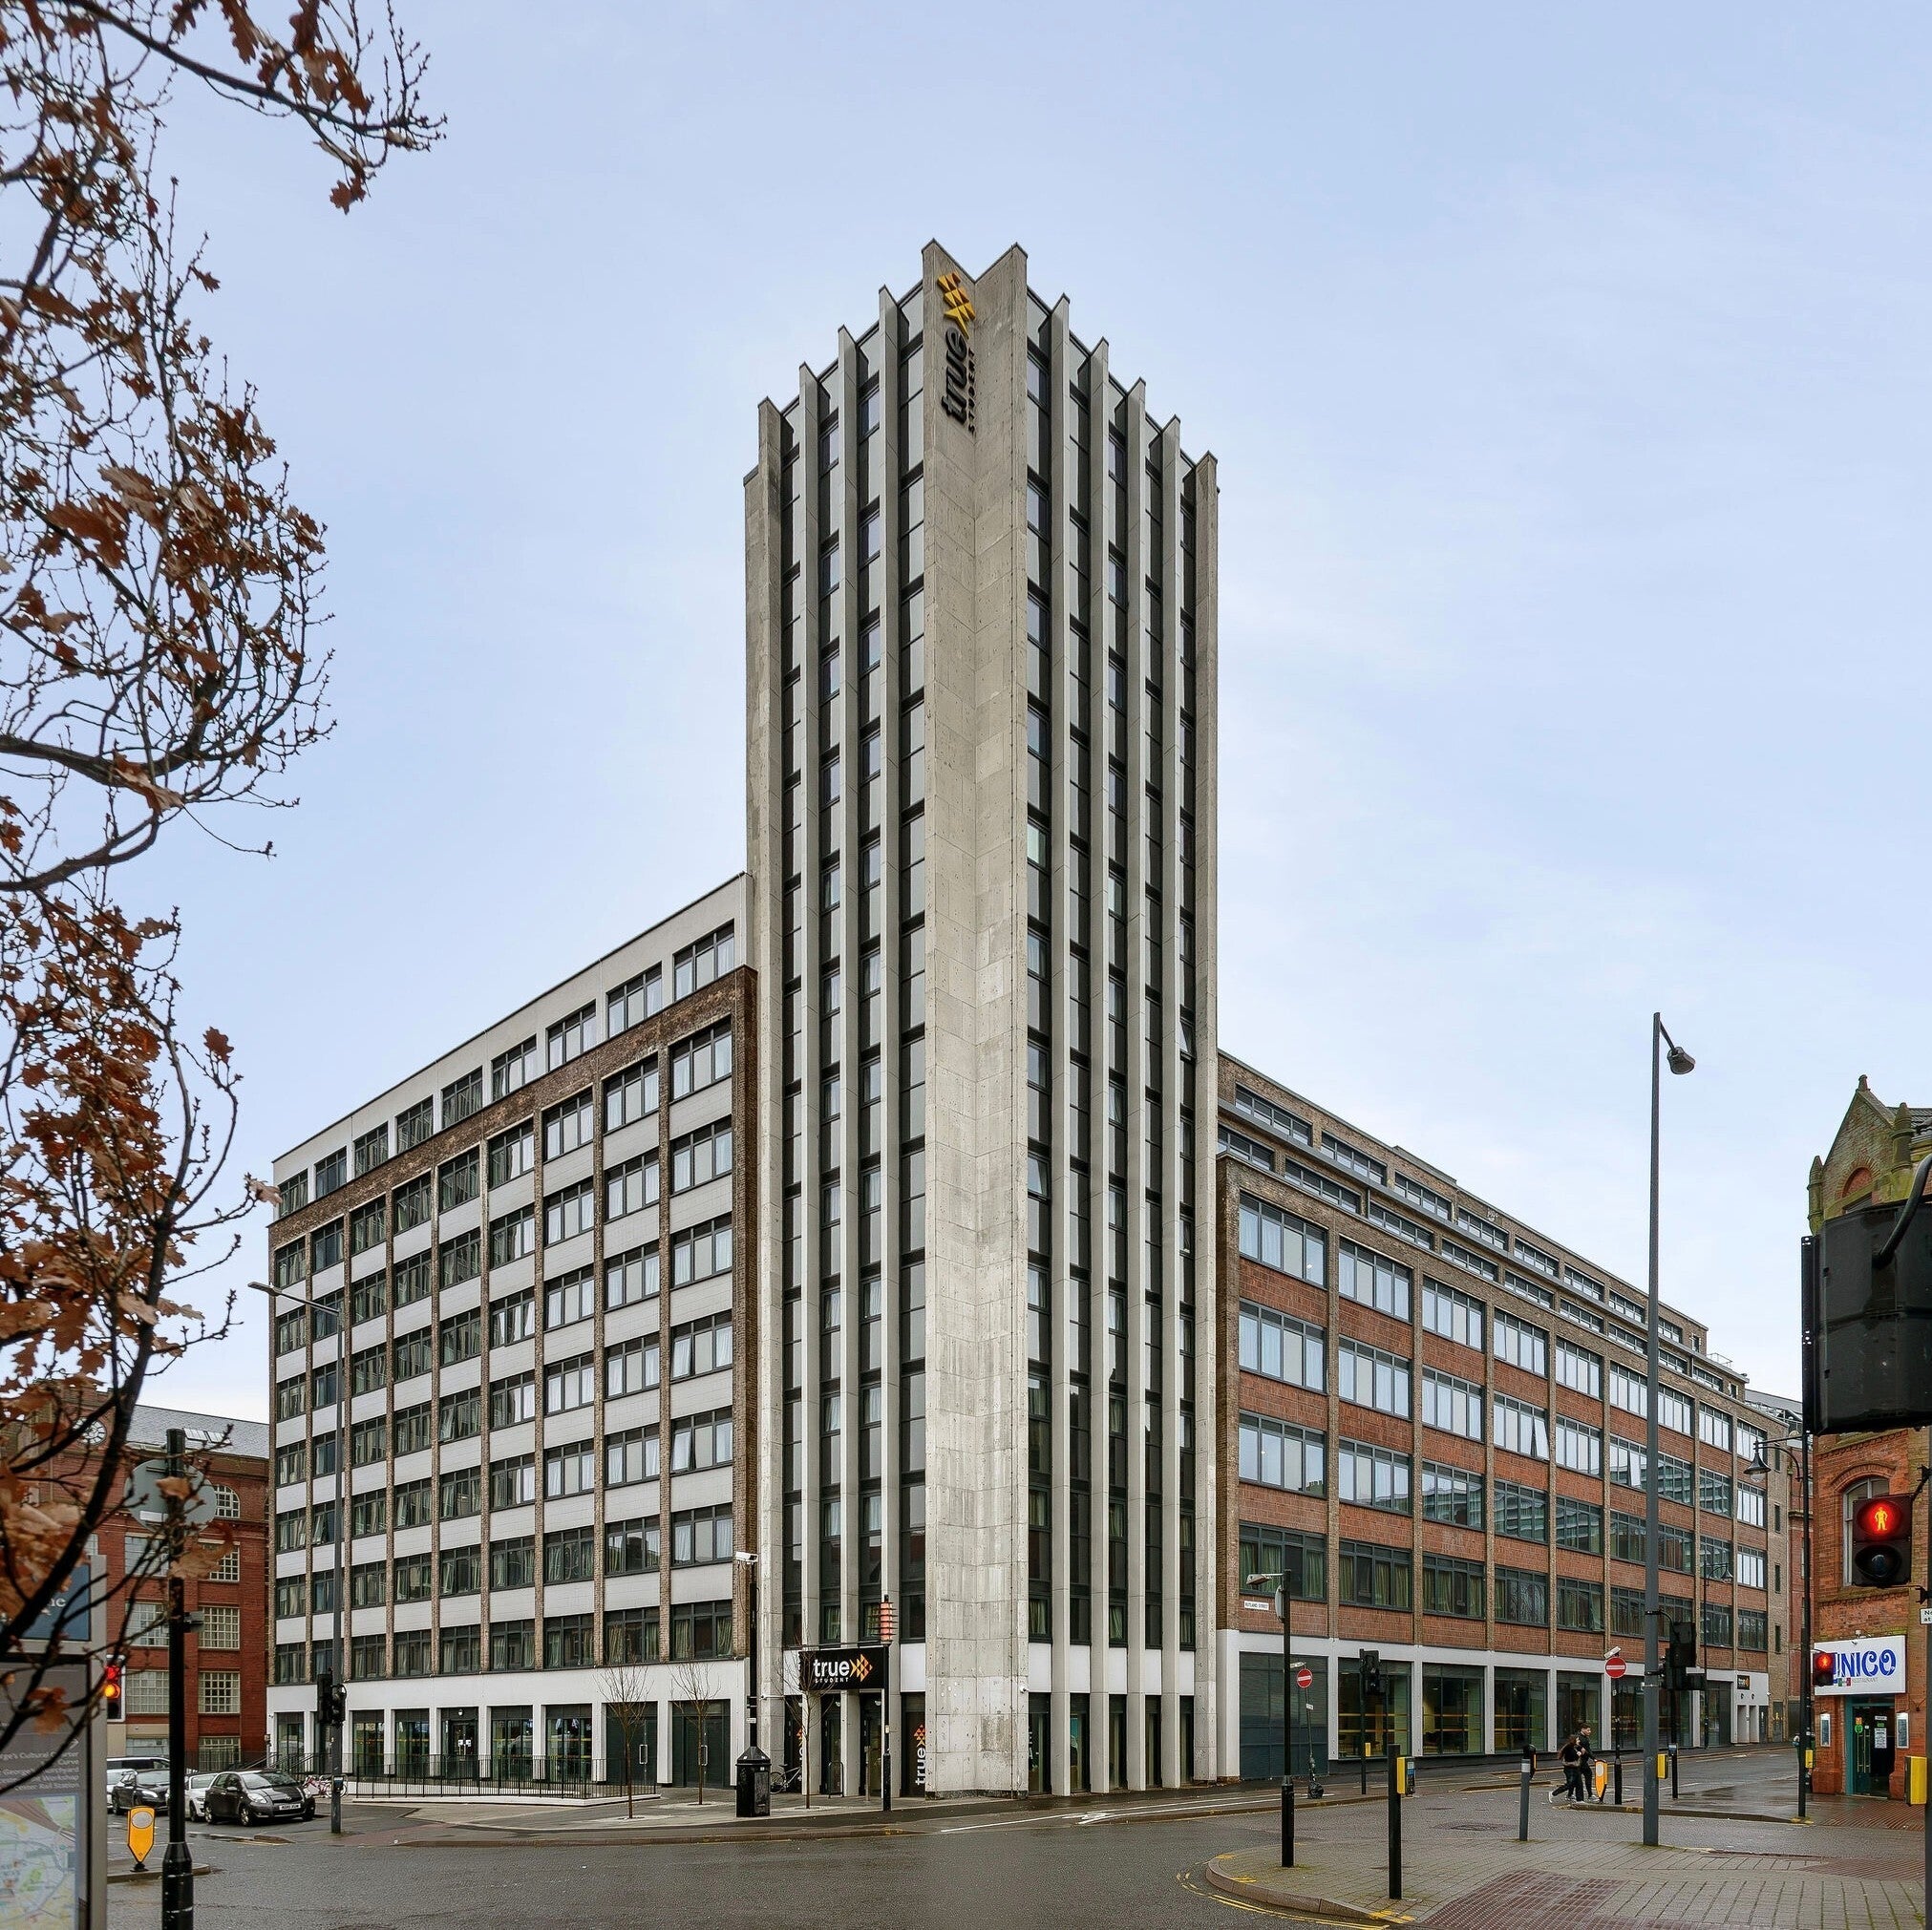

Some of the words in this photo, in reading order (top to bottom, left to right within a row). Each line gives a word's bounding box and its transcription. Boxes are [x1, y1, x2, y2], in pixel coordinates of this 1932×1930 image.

[941, 327, 967, 426] true
[813, 1659, 850, 1677] true
[915, 1747, 926, 1786] true
